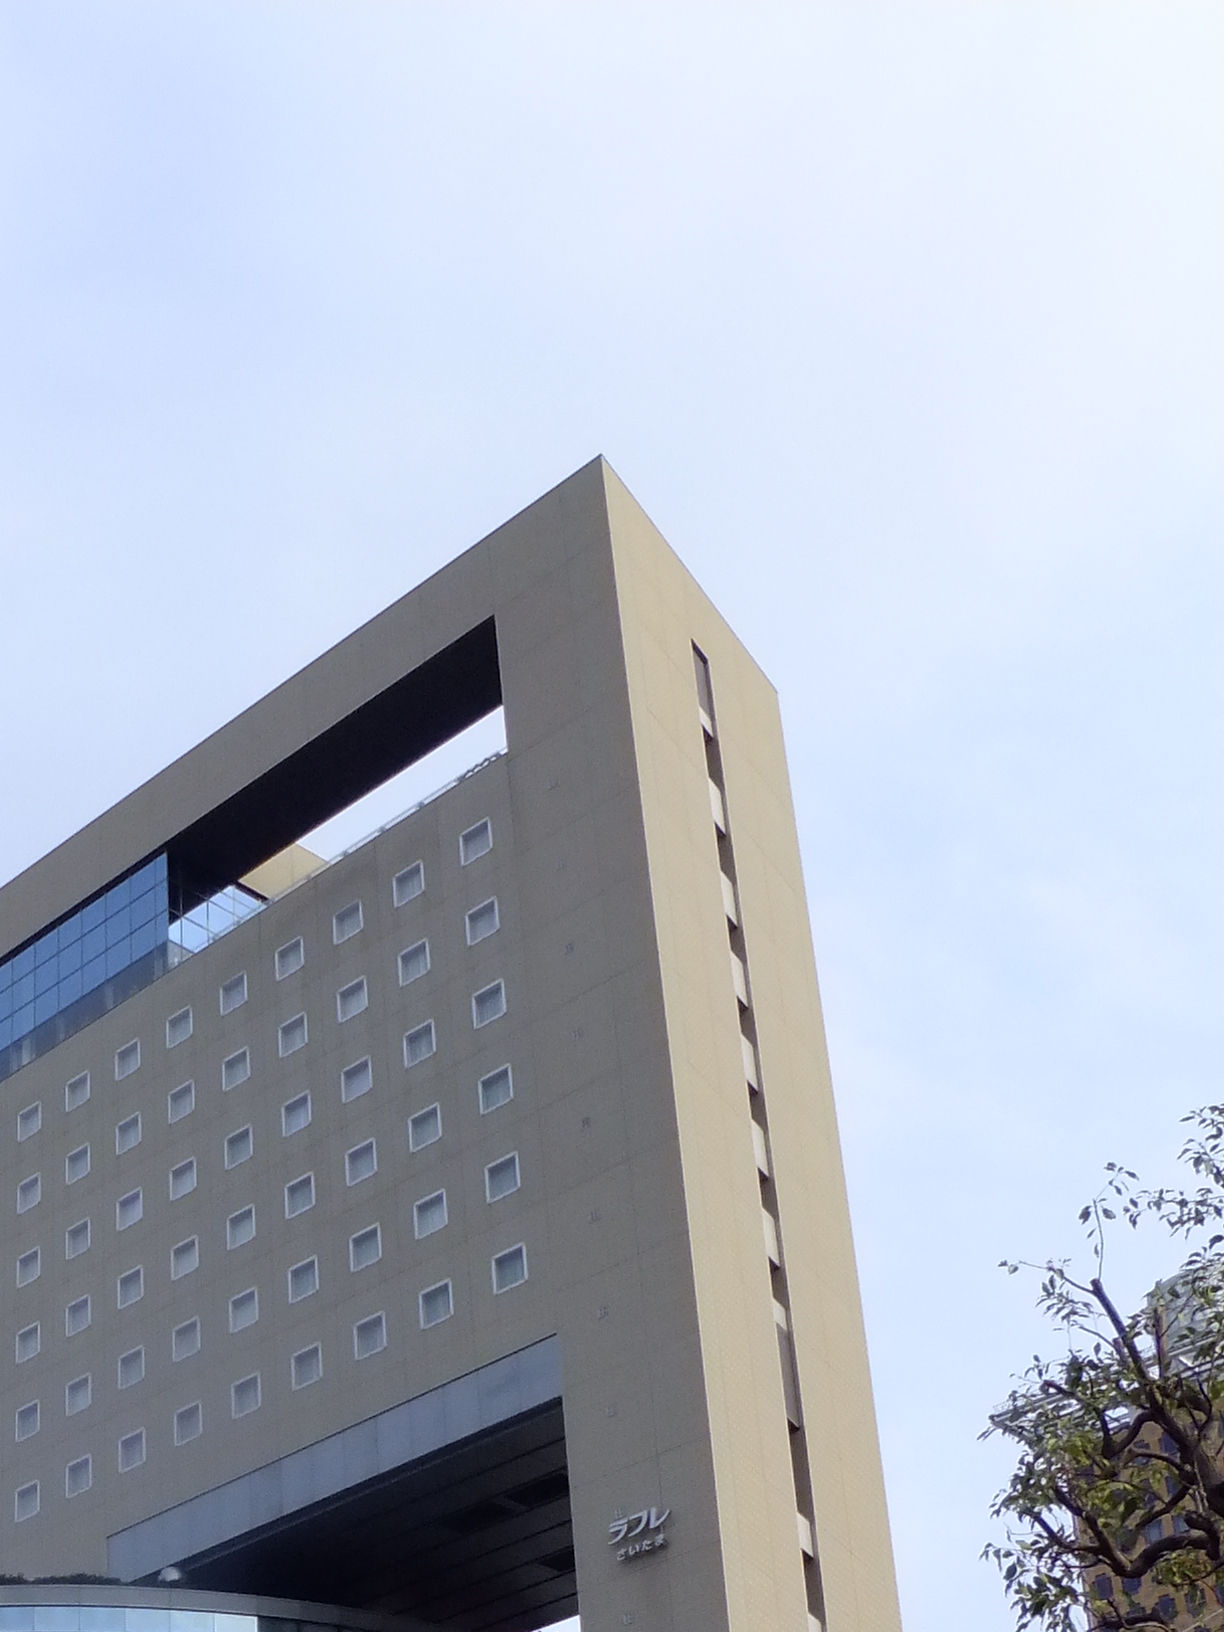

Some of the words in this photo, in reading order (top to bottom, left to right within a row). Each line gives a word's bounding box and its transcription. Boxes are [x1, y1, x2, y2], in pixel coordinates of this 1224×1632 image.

[608, 1507, 670, 1545] ラフレ
[616, 1534, 665, 1561] さいたま
